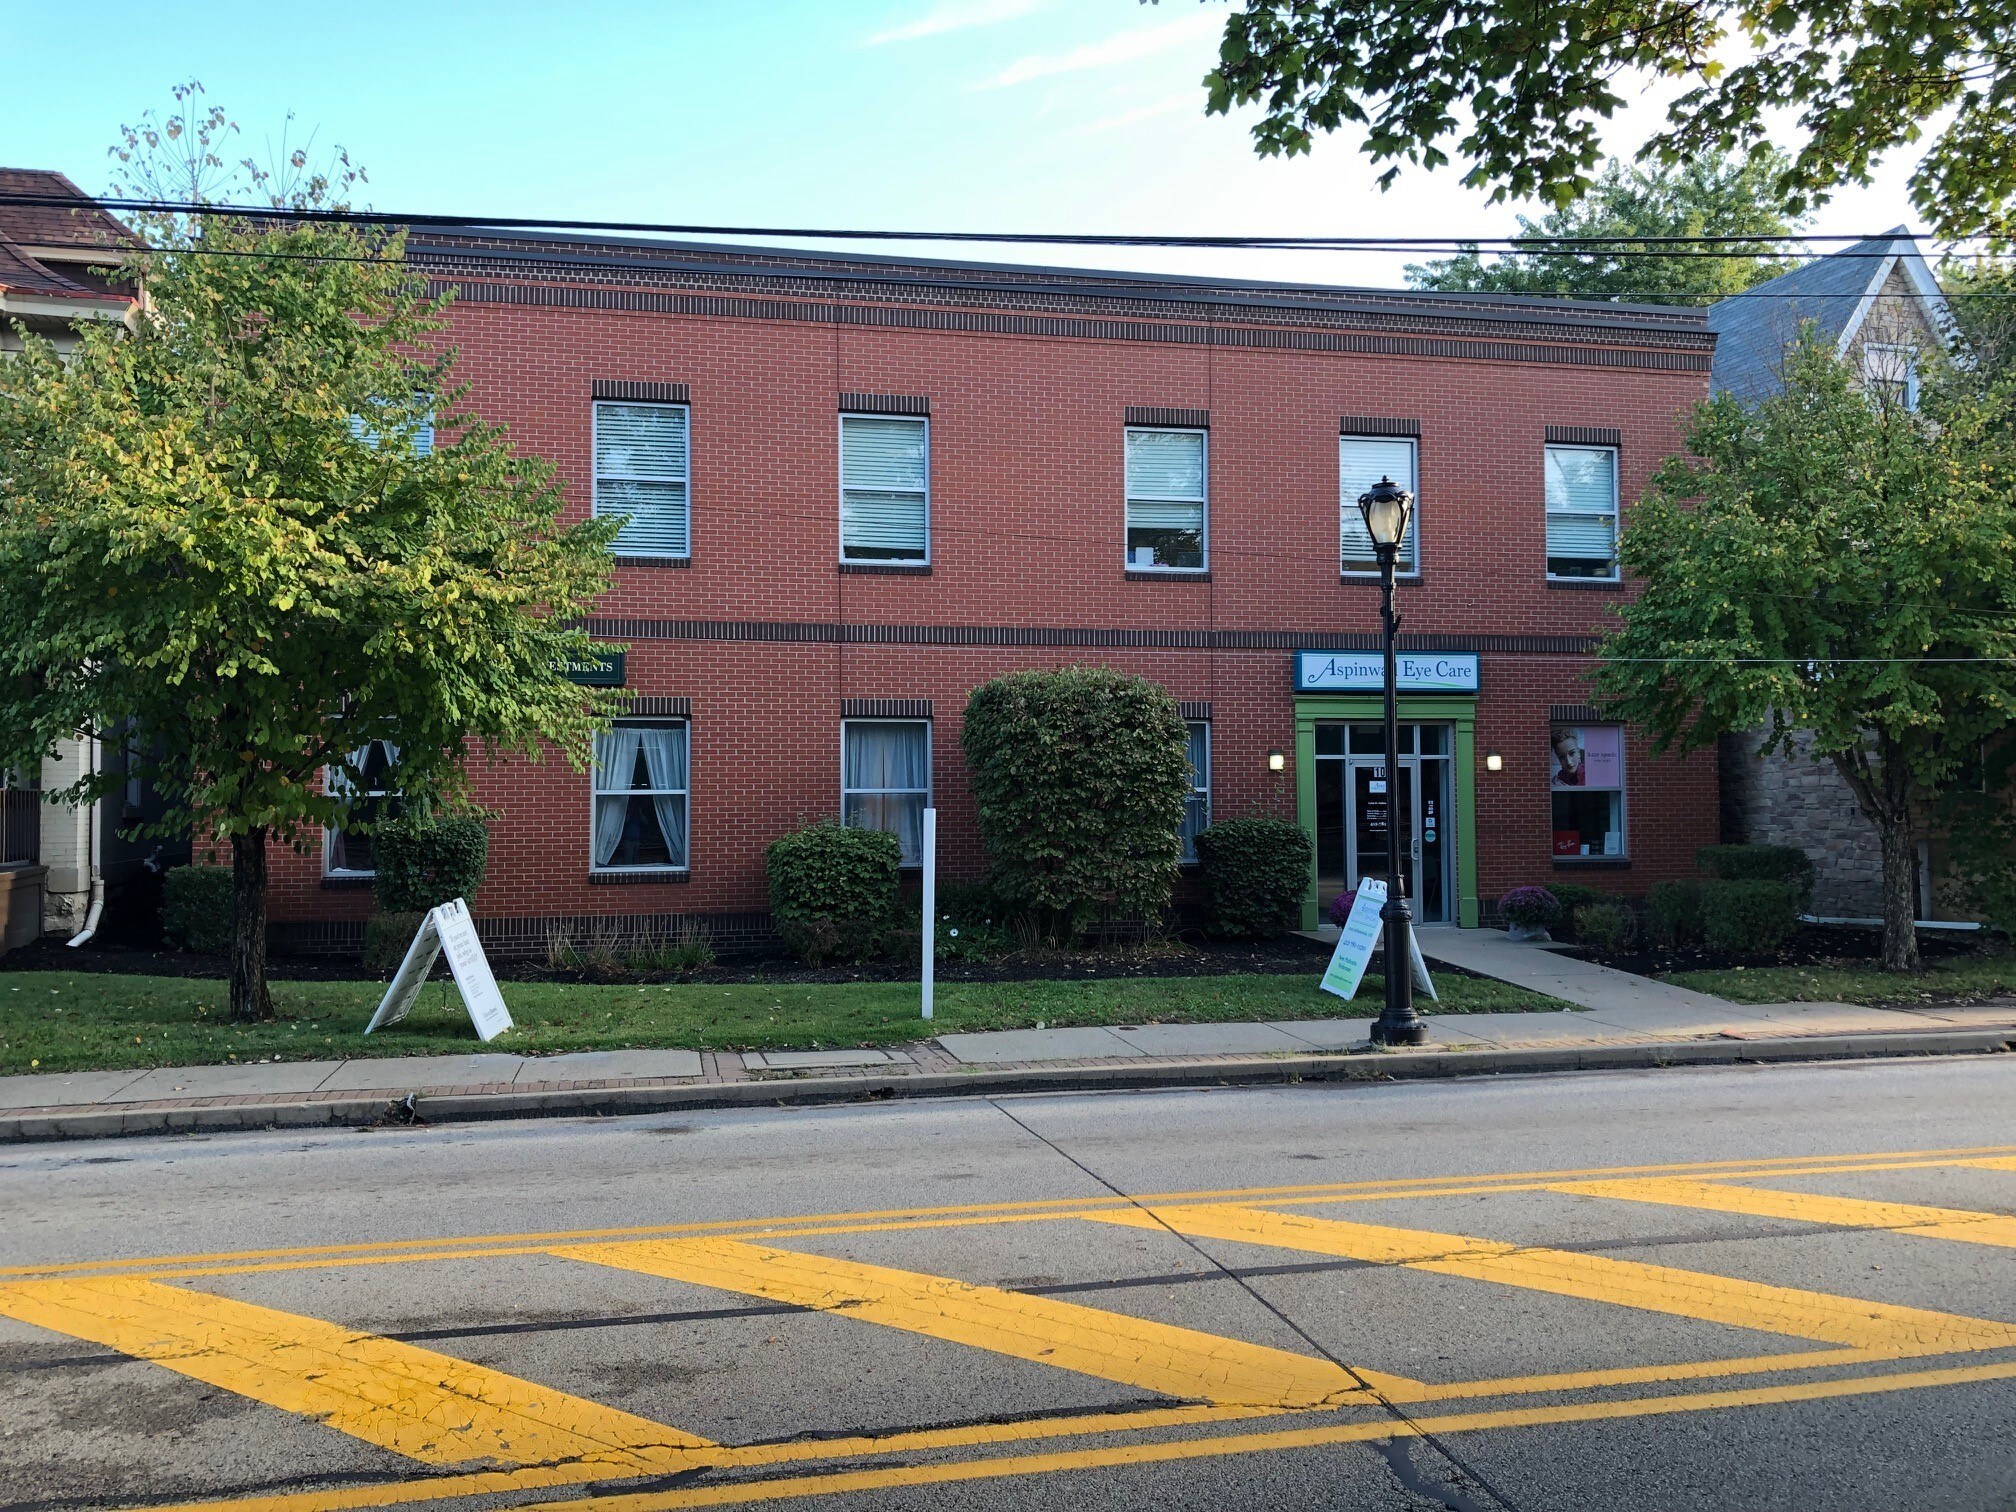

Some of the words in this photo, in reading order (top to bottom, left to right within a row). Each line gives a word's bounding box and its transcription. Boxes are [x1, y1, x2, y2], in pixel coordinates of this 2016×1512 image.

[1308, 657, 1398, 684] Aspinwal
[1403, 660, 1431, 680] Eye
[1436, 660, 1471, 678] Care
